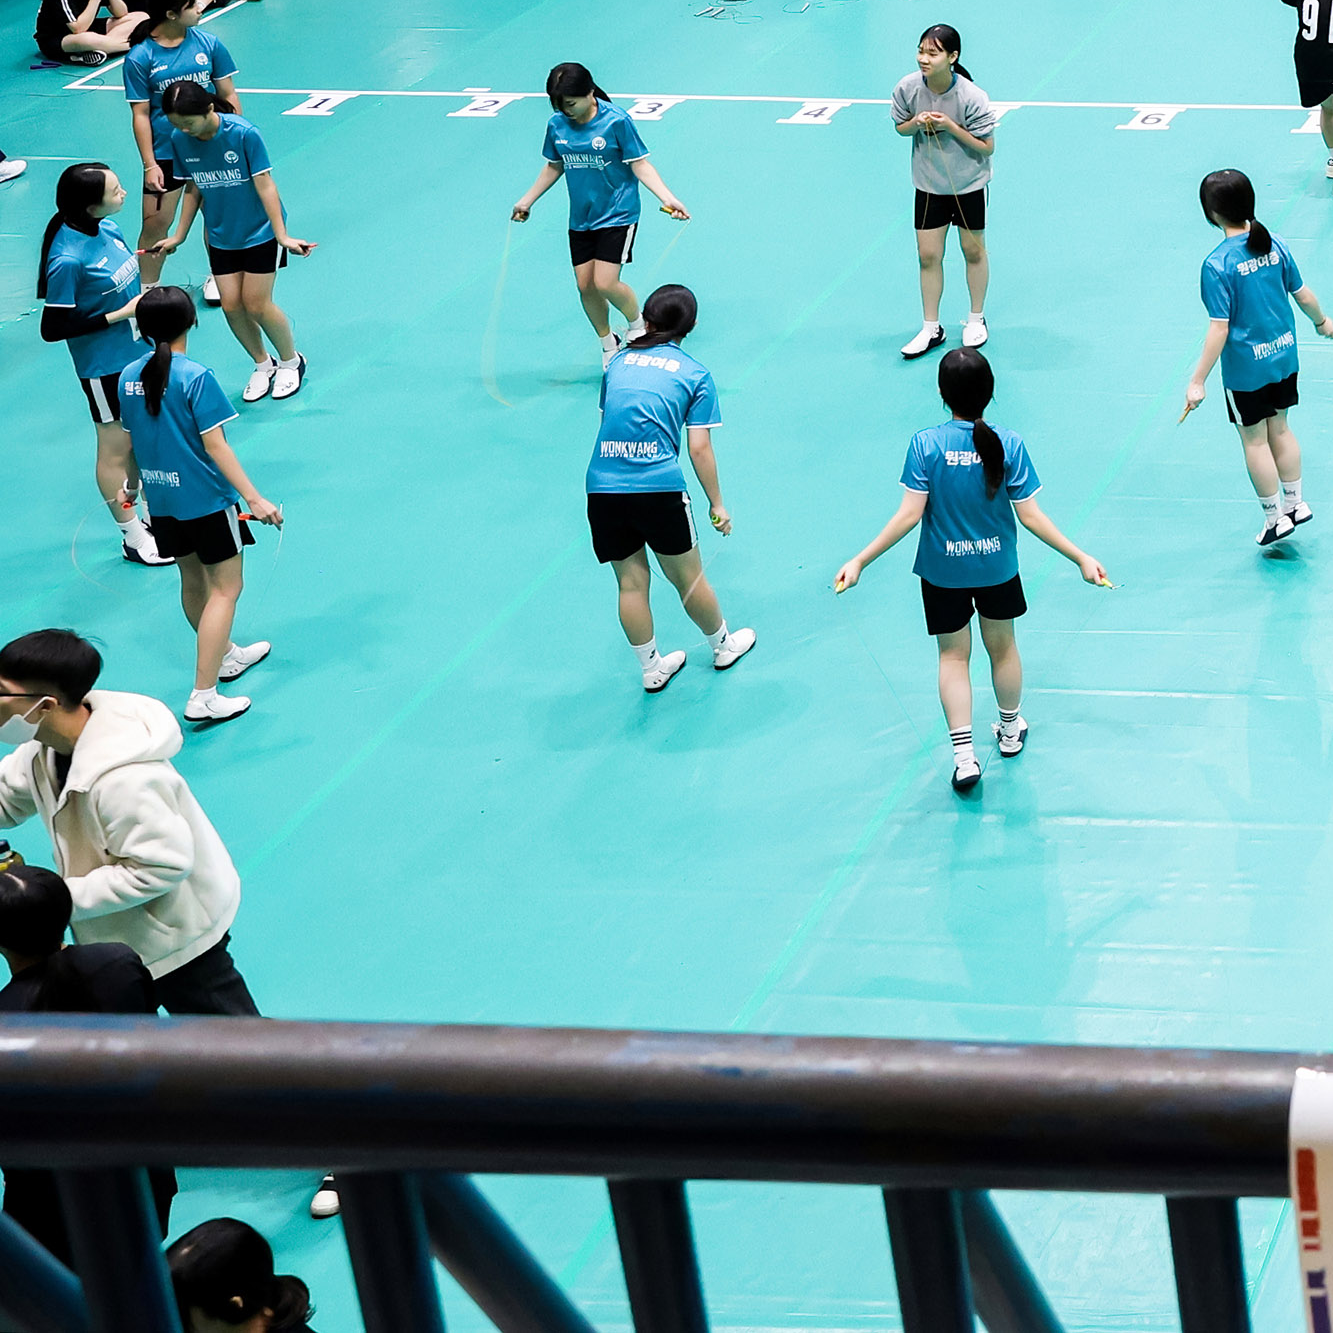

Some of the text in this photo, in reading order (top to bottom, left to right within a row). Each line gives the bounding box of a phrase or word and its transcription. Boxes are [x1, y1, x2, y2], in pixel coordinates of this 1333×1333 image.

[307, 98, 331, 109] 1
[470, 100, 499, 111] 2
[635, 102, 662, 114] 3
[803, 106, 828, 118] 4
[1140, 113, 1165, 125] 6
[1237, 251, 1280, 276] 원광여중
[1252, 331, 1294, 356] WONKWANG
[623, 352, 680, 373] 원광여중
[600, 441, 658, 454] WONKWANG
[946, 536, 1000, 553] WONKWANG
